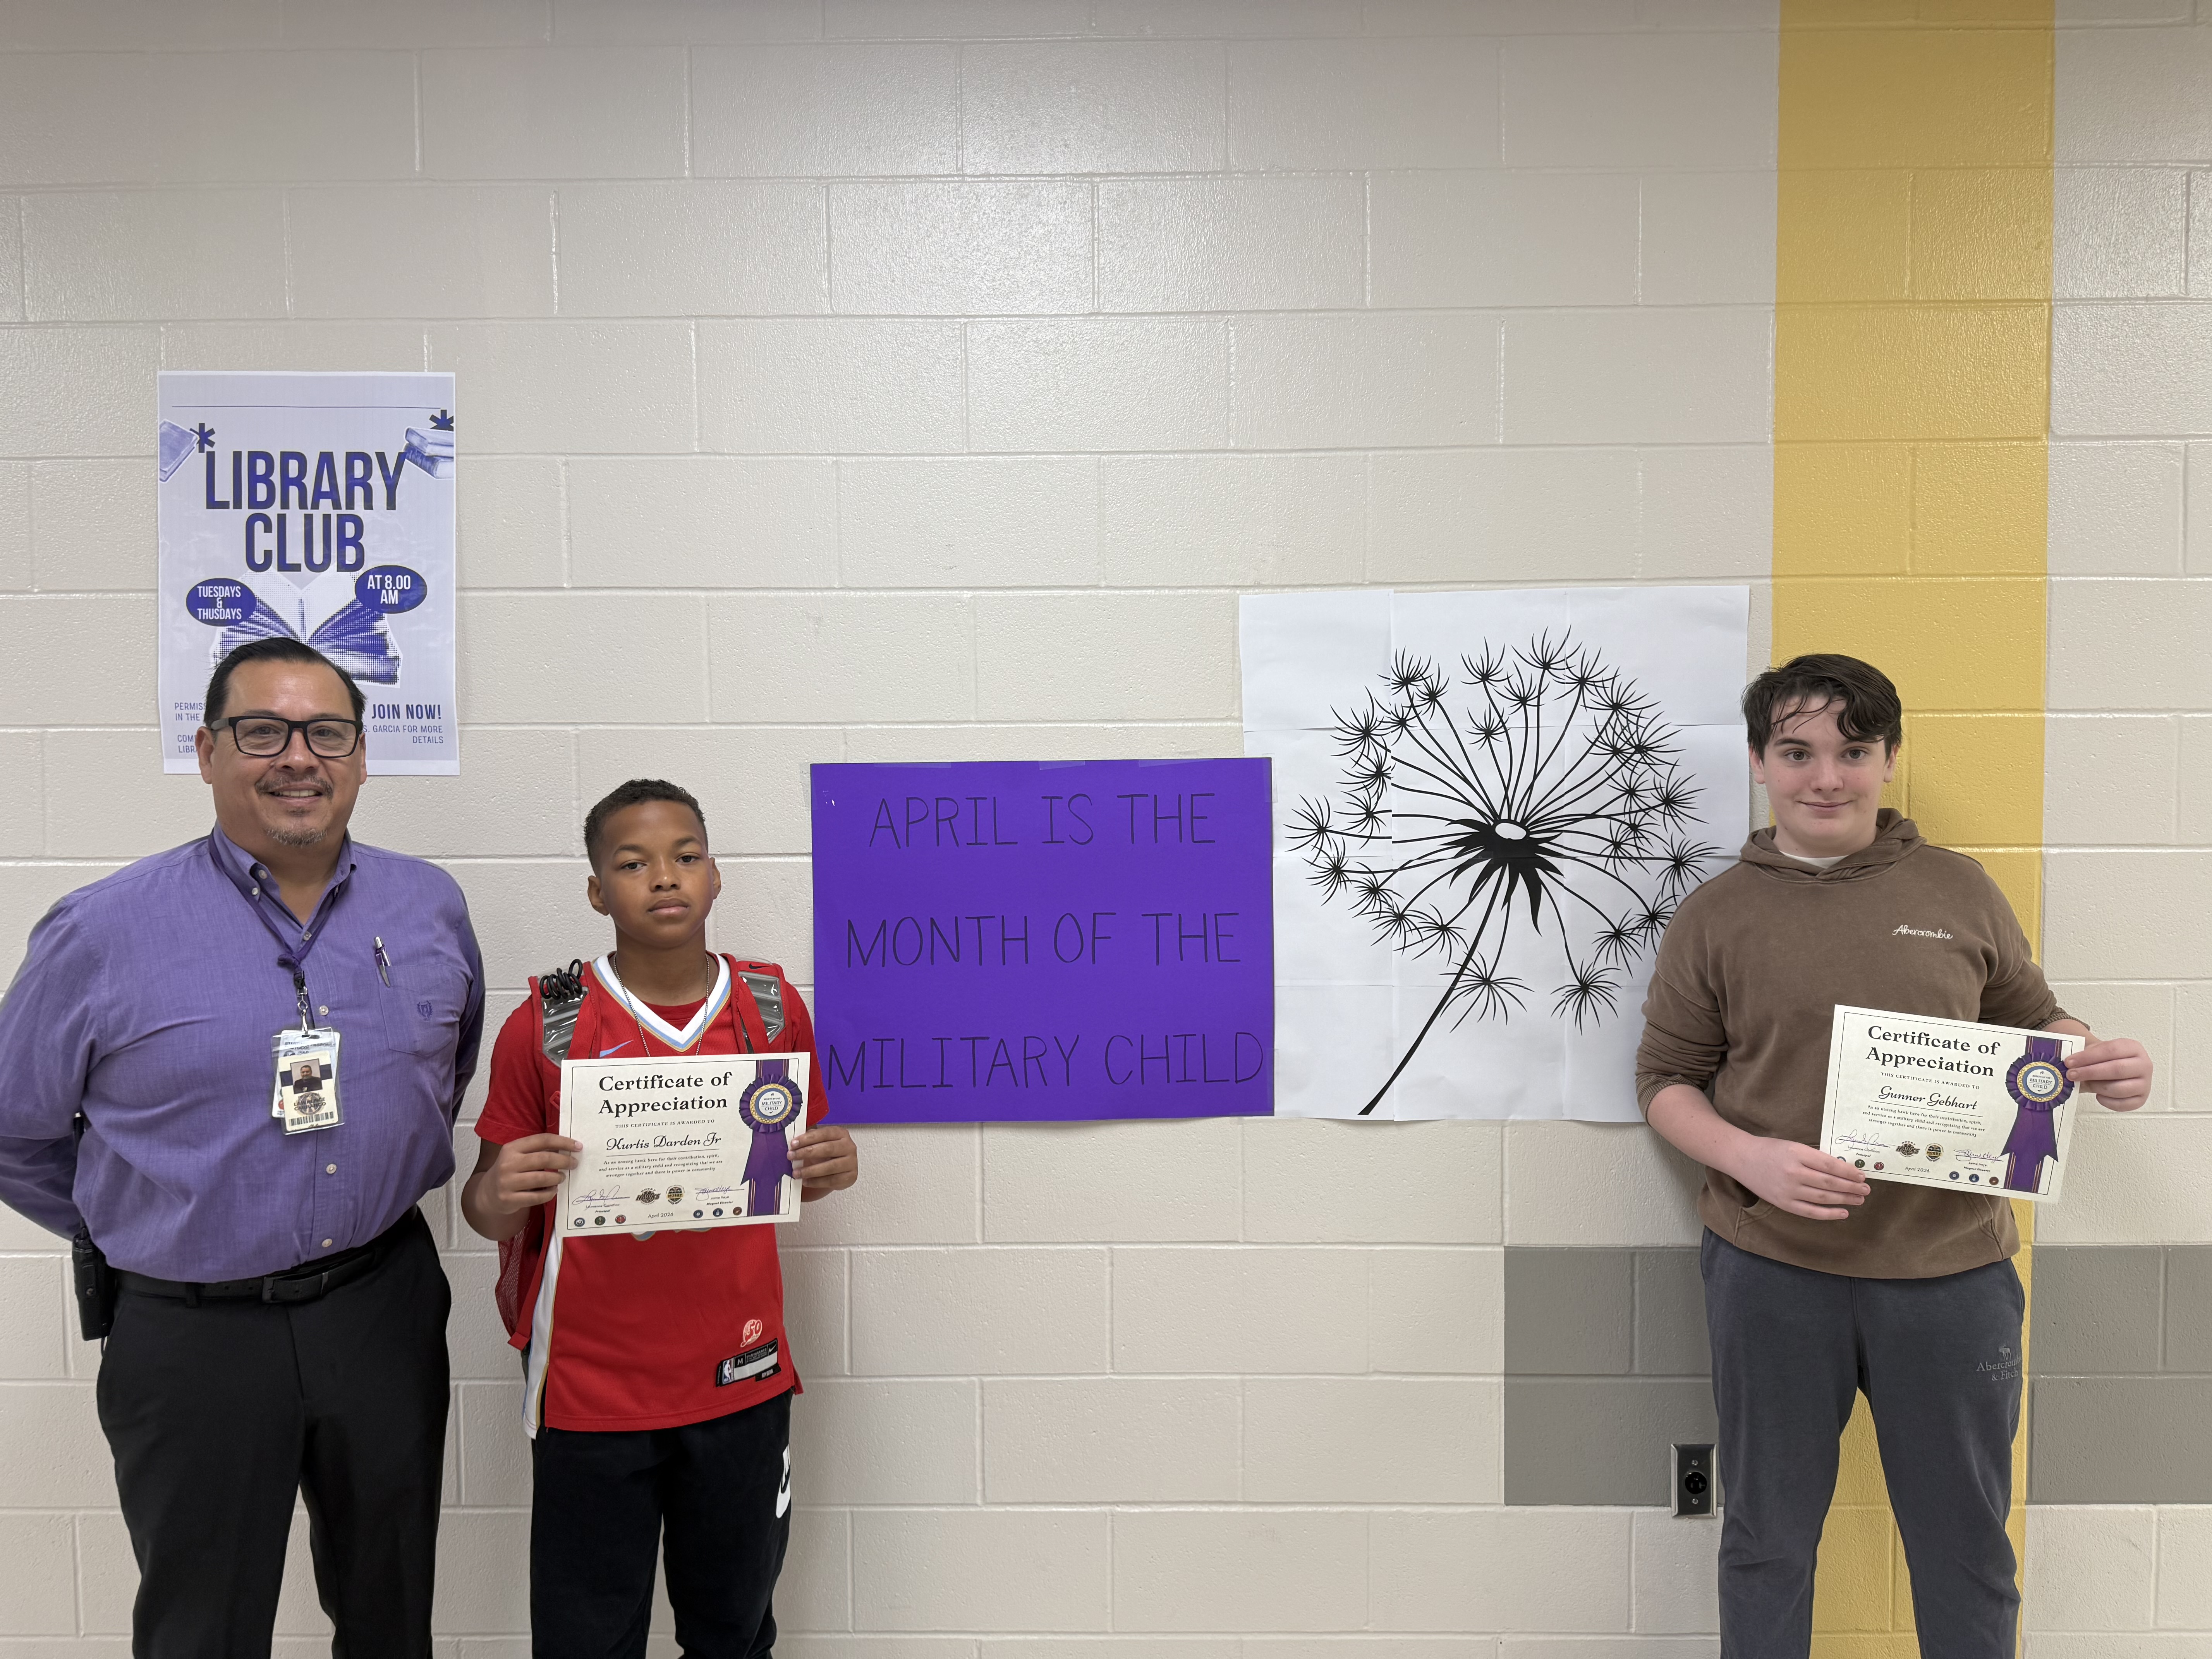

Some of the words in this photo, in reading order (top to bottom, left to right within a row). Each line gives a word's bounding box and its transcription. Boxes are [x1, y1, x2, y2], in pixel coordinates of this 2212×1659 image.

[205, 451, 407, 511] LIBRARY
[246, 513, 365, 572] CLUB
[367, 575, 383, 589] AT
[385, 575, 411, 590] 8.00
[198, 586, 241, 598] TUESDAYS
[380, 590, 398, 605] AM
[216, 598, 222, 608] &
[198, 608, 242, 620] THUSDAYS
[372, 704, 400, 719] JOIN
[406, 704, 441, 719] NOW!
[869, 796, 1018, 849] APRIL
[1041, 793, 1094, 845] IS
[1116, 793, 1216, 844] THE
[847, 915, 1028, 968] MONTH
[1054, 912, 1116, 965] OF
[1141, 912, 1241, 966] THE
[1892, 925, 1953, 939] Abercrombie
[1868, 1025, 1970, 1051] Certificate
[1978, 1042, 2001, 1055] of
[828, 1034, 1080, 1092] MILITARY
[1105, 1032, 1264, 1085] CHILD
[1866, 1047, 1994, 1077] Appreciation
[599, 1075, 704, 1091] Certificate
[711, 1072, 732, 1086] of
[1896, 1074, 1932, 1083] CERTIFICATE
[1878, 1086, 1925, 1102] Gunner
[1927, 1093, 1977, 1109] Gebhart
[598, 1096, 728, 1118] Appreciation
[606, 1138, 649, 1150] Kurtis
[654, 1135, 701, 1147] Darden
[2001, 1367, 2018, 1380] Fitch
